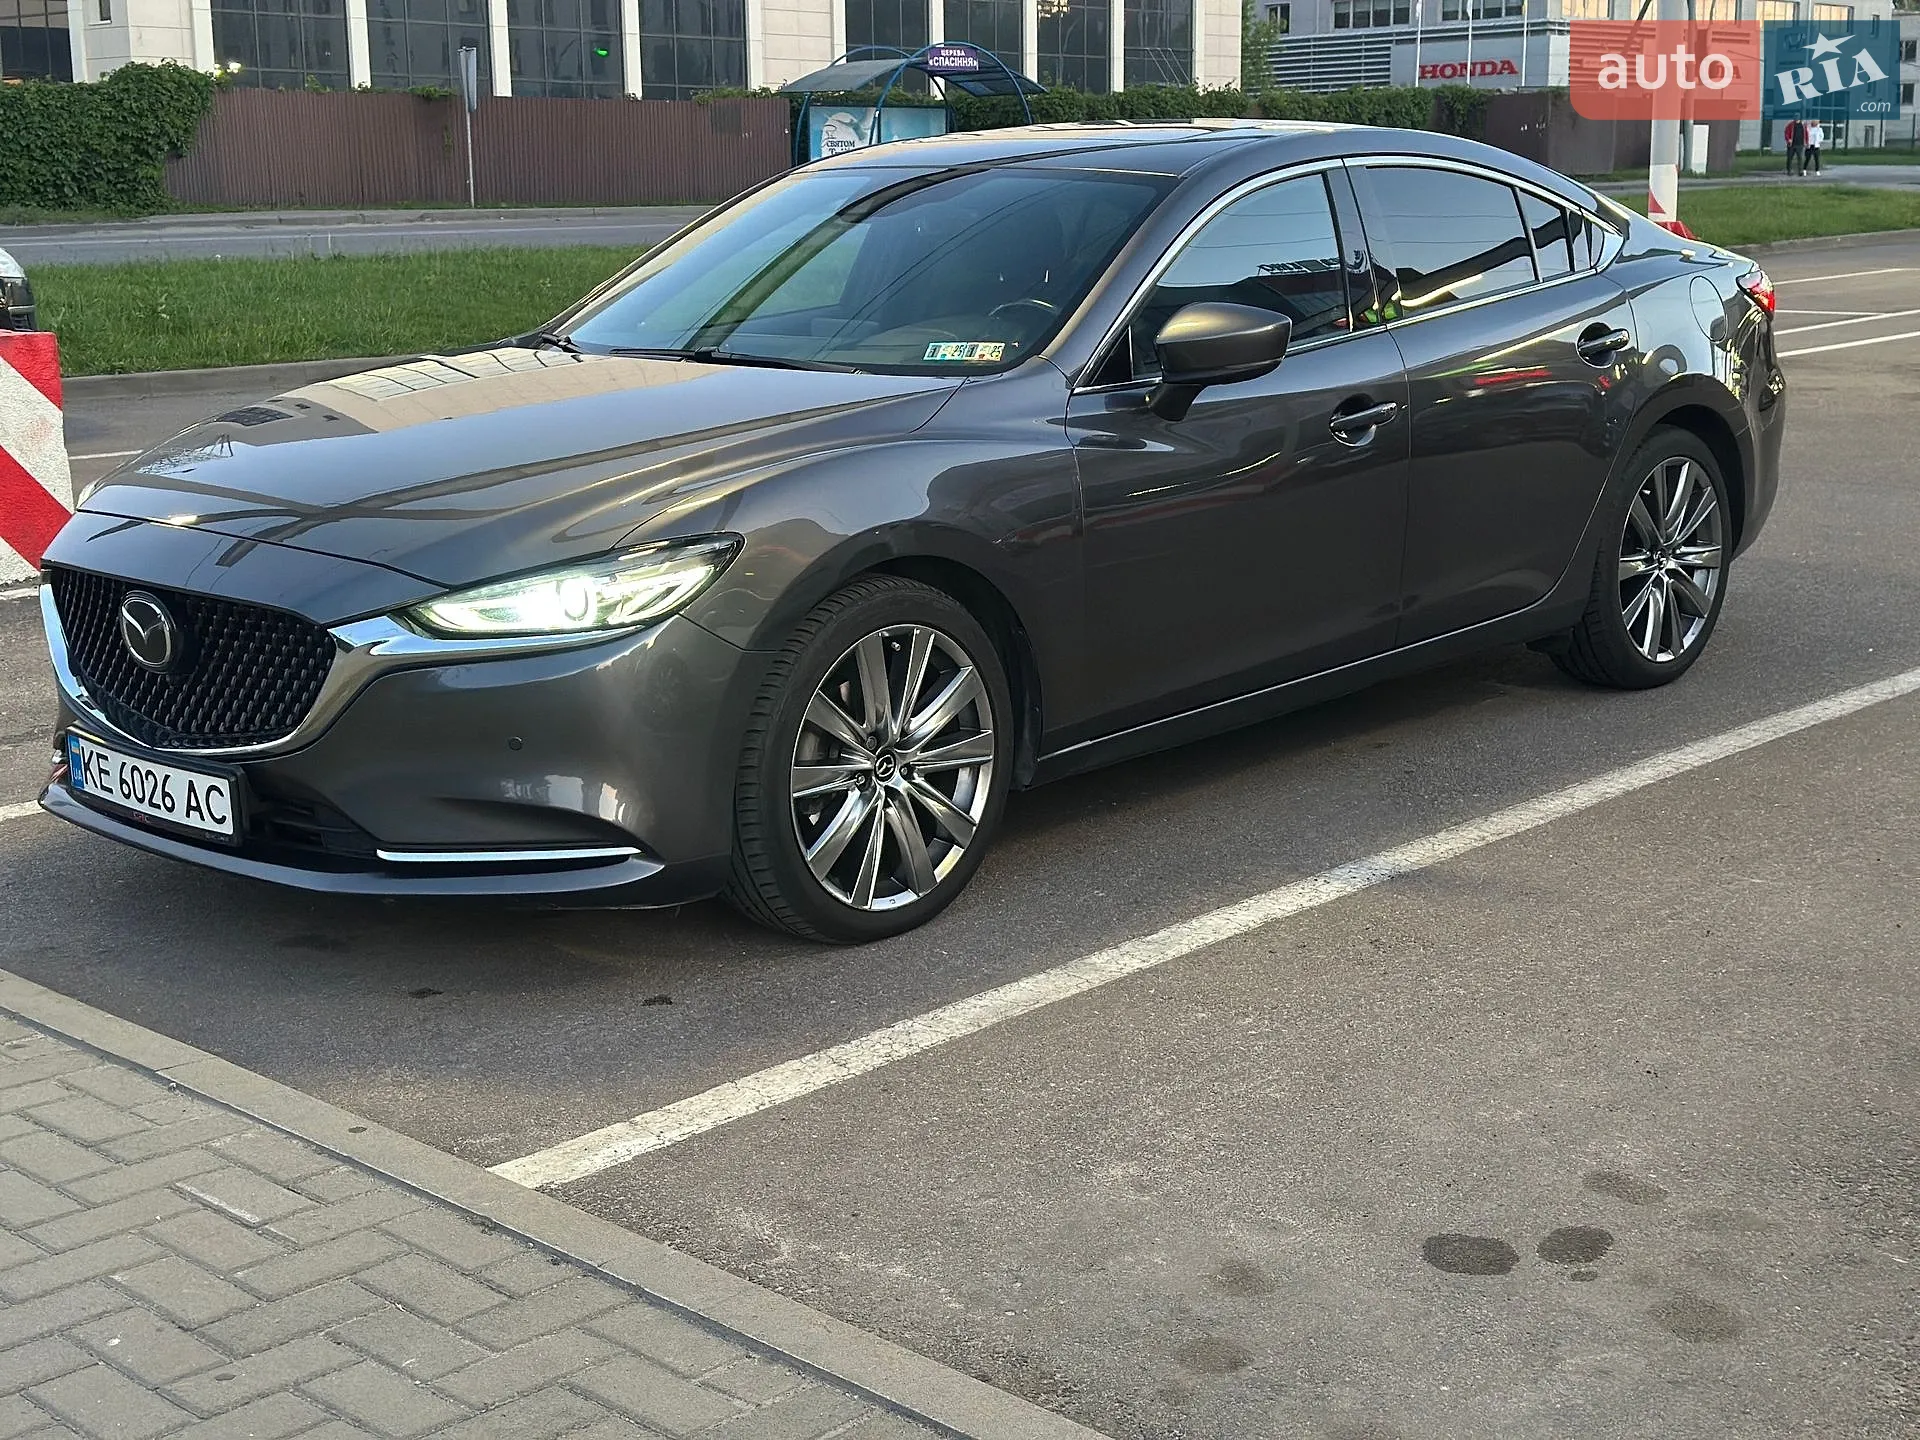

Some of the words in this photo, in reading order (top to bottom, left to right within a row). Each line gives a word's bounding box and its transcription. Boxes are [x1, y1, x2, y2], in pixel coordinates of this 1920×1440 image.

[1418, 60, 1519, 80] HONDA
[81, 745, 114, 795] KE
[119, 761, 176, 813] 6026
[185, 779, 227, 825] AC
